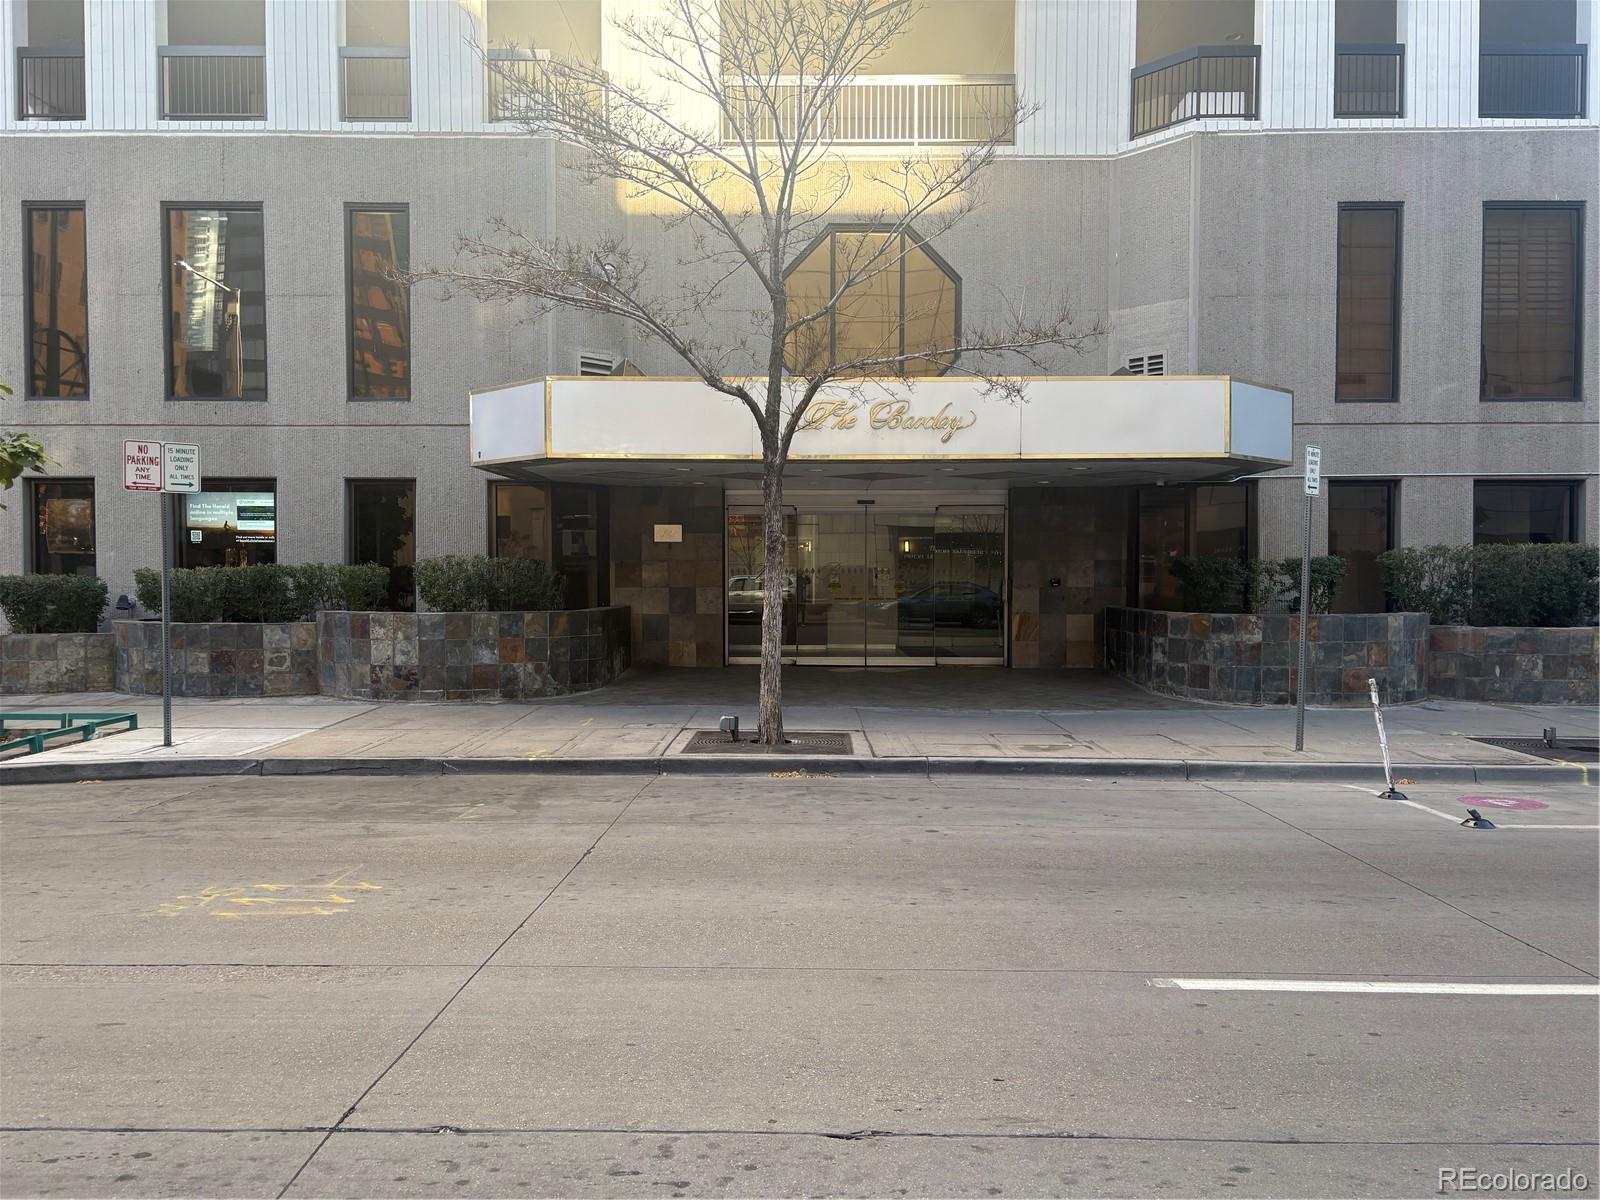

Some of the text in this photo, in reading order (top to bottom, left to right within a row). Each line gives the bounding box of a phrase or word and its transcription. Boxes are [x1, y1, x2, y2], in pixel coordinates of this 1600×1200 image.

[797, 399, 977, 444] The Barclay
[138, 444, 148, 454] NO
[175, 447, 196, 455] MINUTE
[126, 455, 159, 466] PARKING
[174, 464, 189, 472] ONLY
